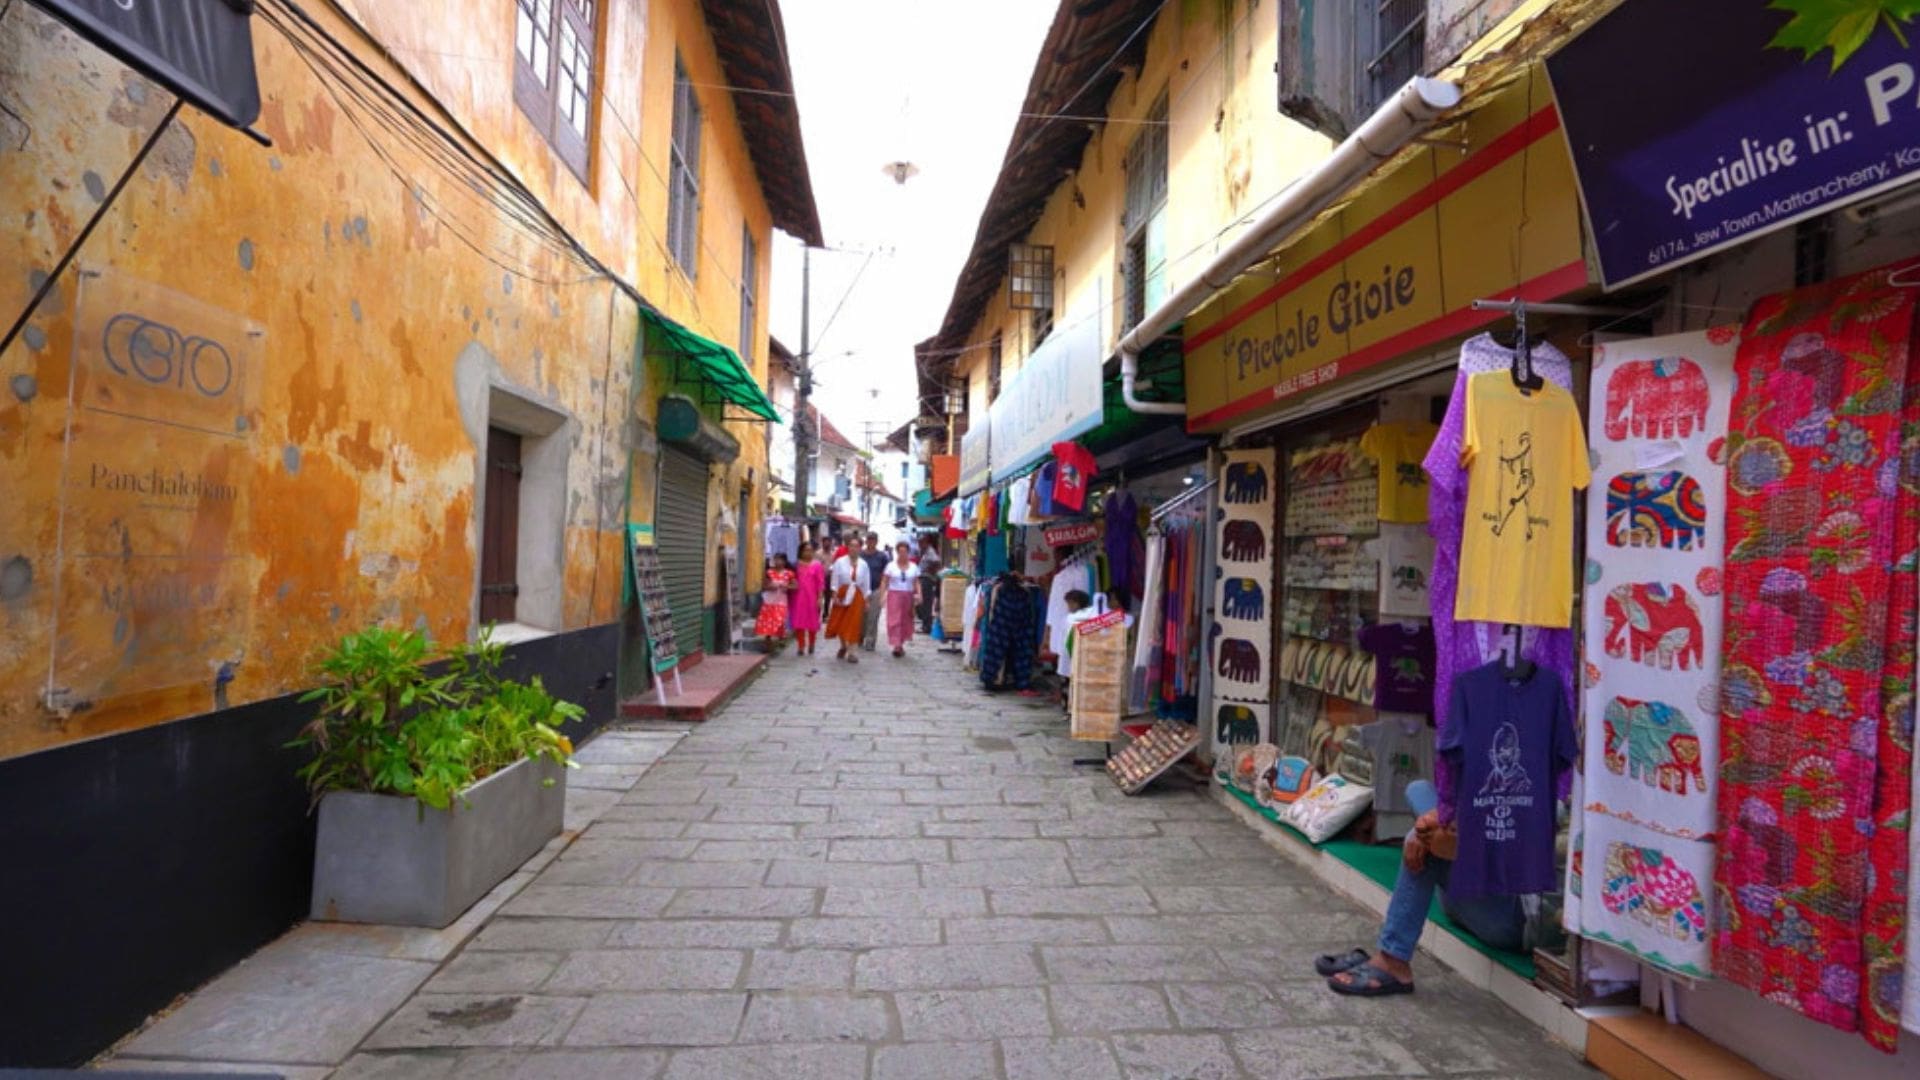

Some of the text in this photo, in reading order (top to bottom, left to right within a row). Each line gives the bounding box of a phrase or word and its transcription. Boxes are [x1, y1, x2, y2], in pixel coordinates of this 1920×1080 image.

[1665, 62, 1920, 219] Specialise in: P
[1692, 227, 1720, 247] Jew
[1236, 310, 1320, 380] Piccole
[1327, 264, 1415, 333] Gioie
